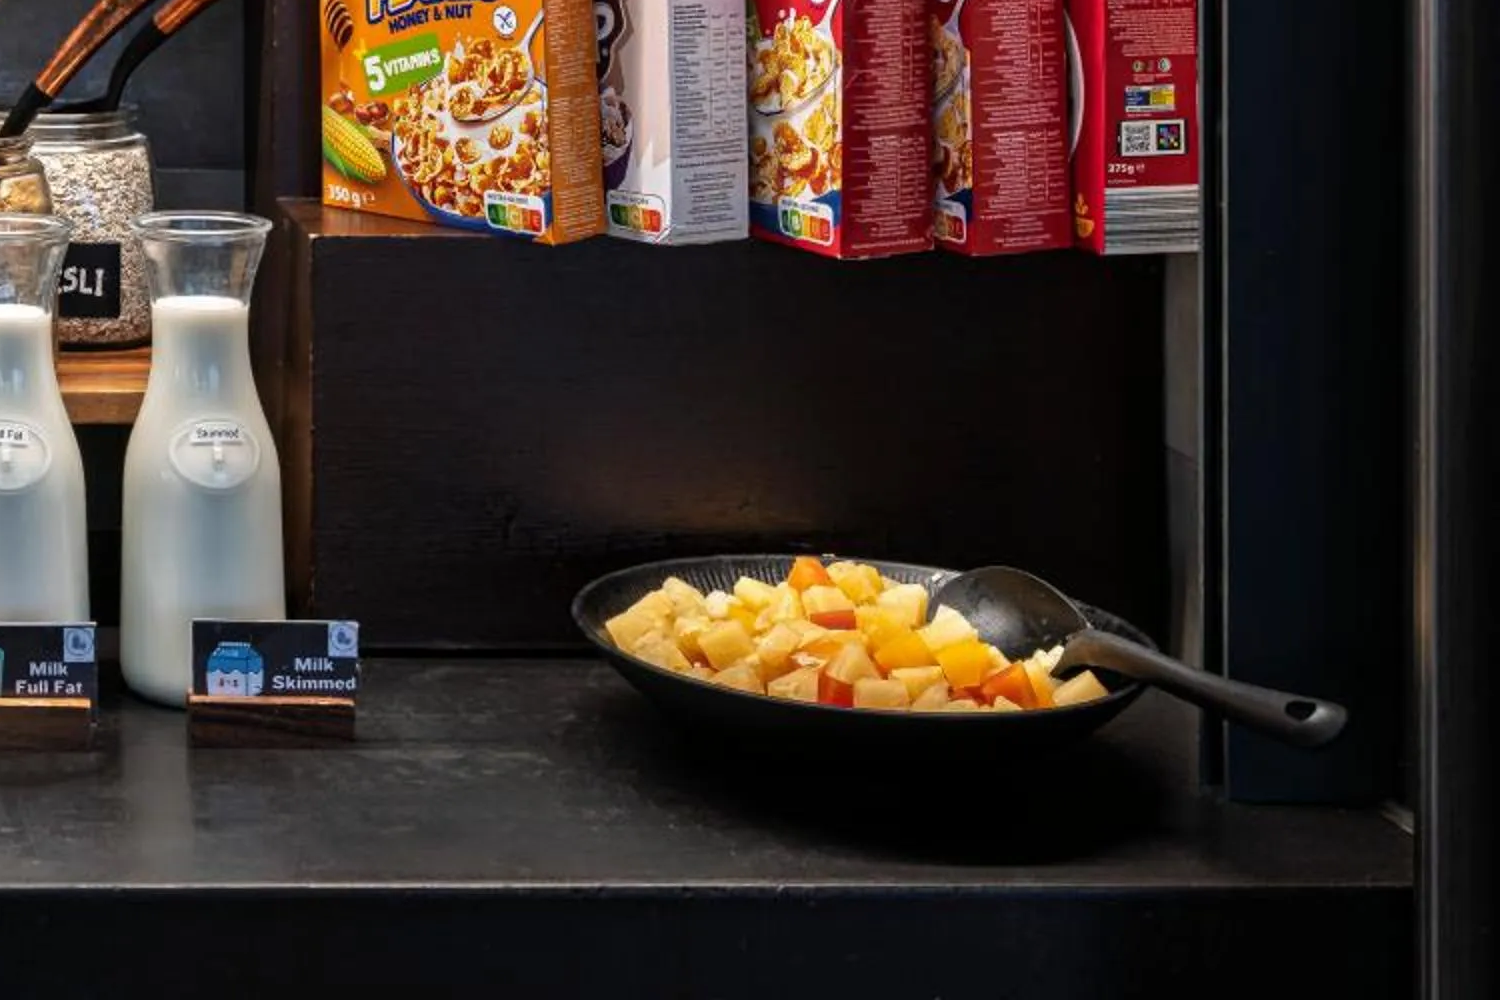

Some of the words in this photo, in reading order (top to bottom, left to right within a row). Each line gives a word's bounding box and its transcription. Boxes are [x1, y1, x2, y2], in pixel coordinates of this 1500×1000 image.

[388, 10, 432, 34] HONEY
[434, 8, 443, 21] &
[445, 3, 473, 20] NUT
[364, 54, 386, 92] 5
[384, 48, 441, 77] VITAMINS
[63, 265, 104, 297] SLI
[29, 661, 68, 677] Milk
[293, 657, 334, 672] Milk
[15, 679, 49, 695] Full
[54, 679, 84, 695] Fat
[272, 675, 357, 690] Skimmed
